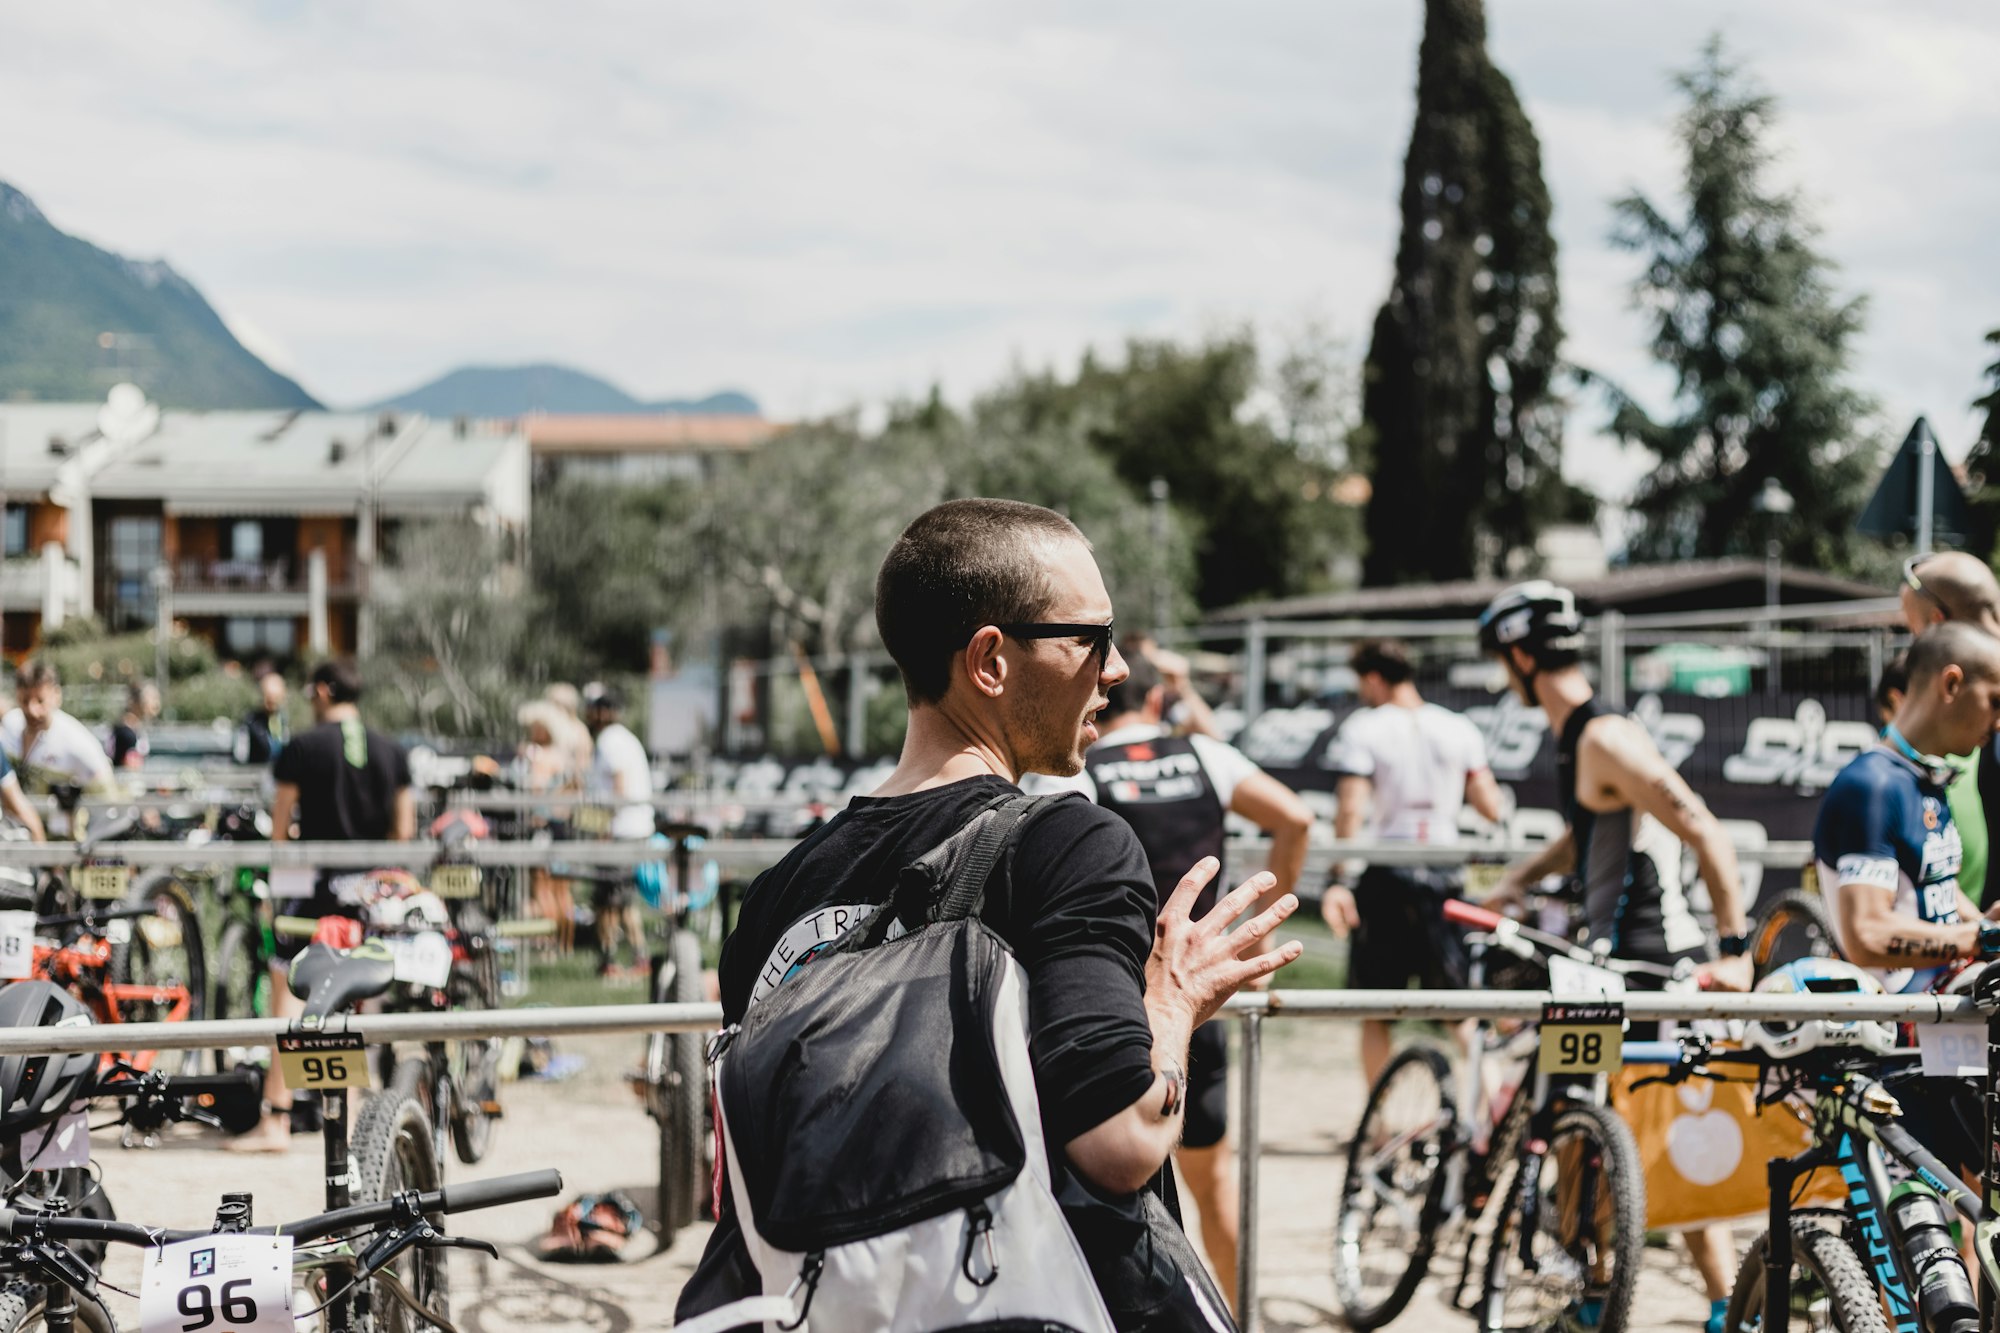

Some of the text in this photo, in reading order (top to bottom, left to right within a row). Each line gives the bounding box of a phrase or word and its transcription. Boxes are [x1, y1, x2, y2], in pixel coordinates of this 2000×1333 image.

[751, 938, 795, 1004] THE
[805, 907, 876, 939] TRA
[302, 1056, 347, 1082] 96
[1560, 1032, 1602, 1066] 98
[177, 1278, 258, 1333] 96
